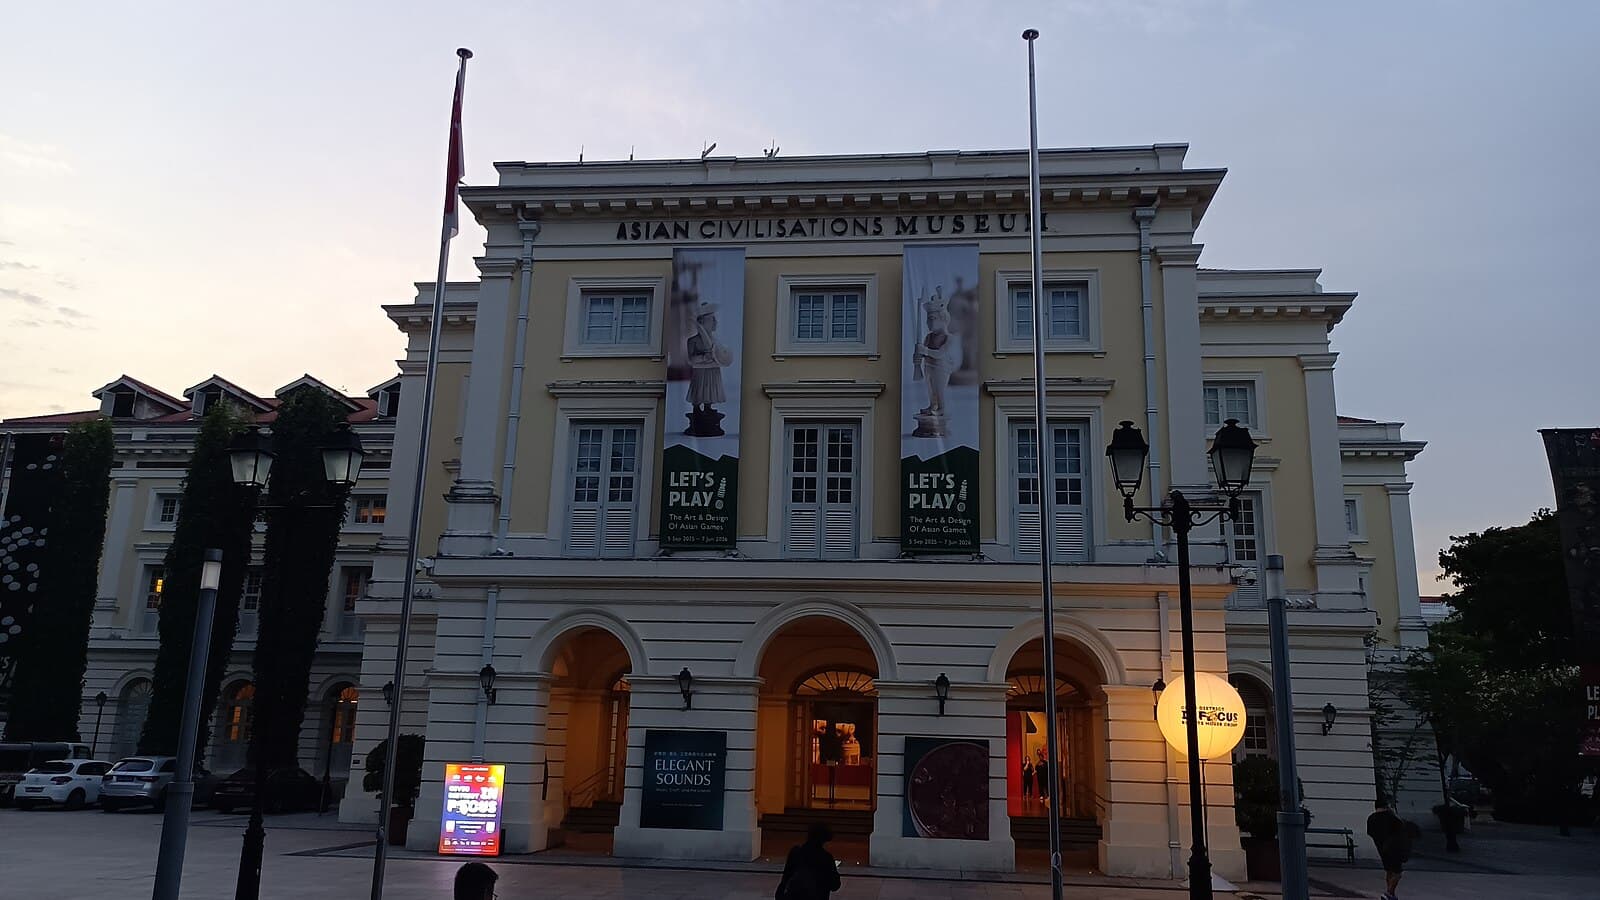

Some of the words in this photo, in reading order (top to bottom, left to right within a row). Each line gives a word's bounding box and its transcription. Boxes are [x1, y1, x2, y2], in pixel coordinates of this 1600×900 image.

[616, 221, 689, 240] ASIAN
[700, 217, 883, 239] CIVILISATIONS
[895, 212, 1049, 235] MUSEUM
[669, 471, 714, 487] LET'S
[909, 472, 955, 489] LET'S
[669, 513, 682, 521] The
[683, 513, 697, 521] Art
[705, 513, 729, 523] Design
[909, 515, 923, 523] The
[947, 516, 972, 526] Design
[700, 522, 724, 531] Games
[921, 525, 941, 533] Asian
[942, 525, 967, 534] Games
[655, 758, 716, 772] ELEGANT
[655, 772, 711, 785] SOUNDS
